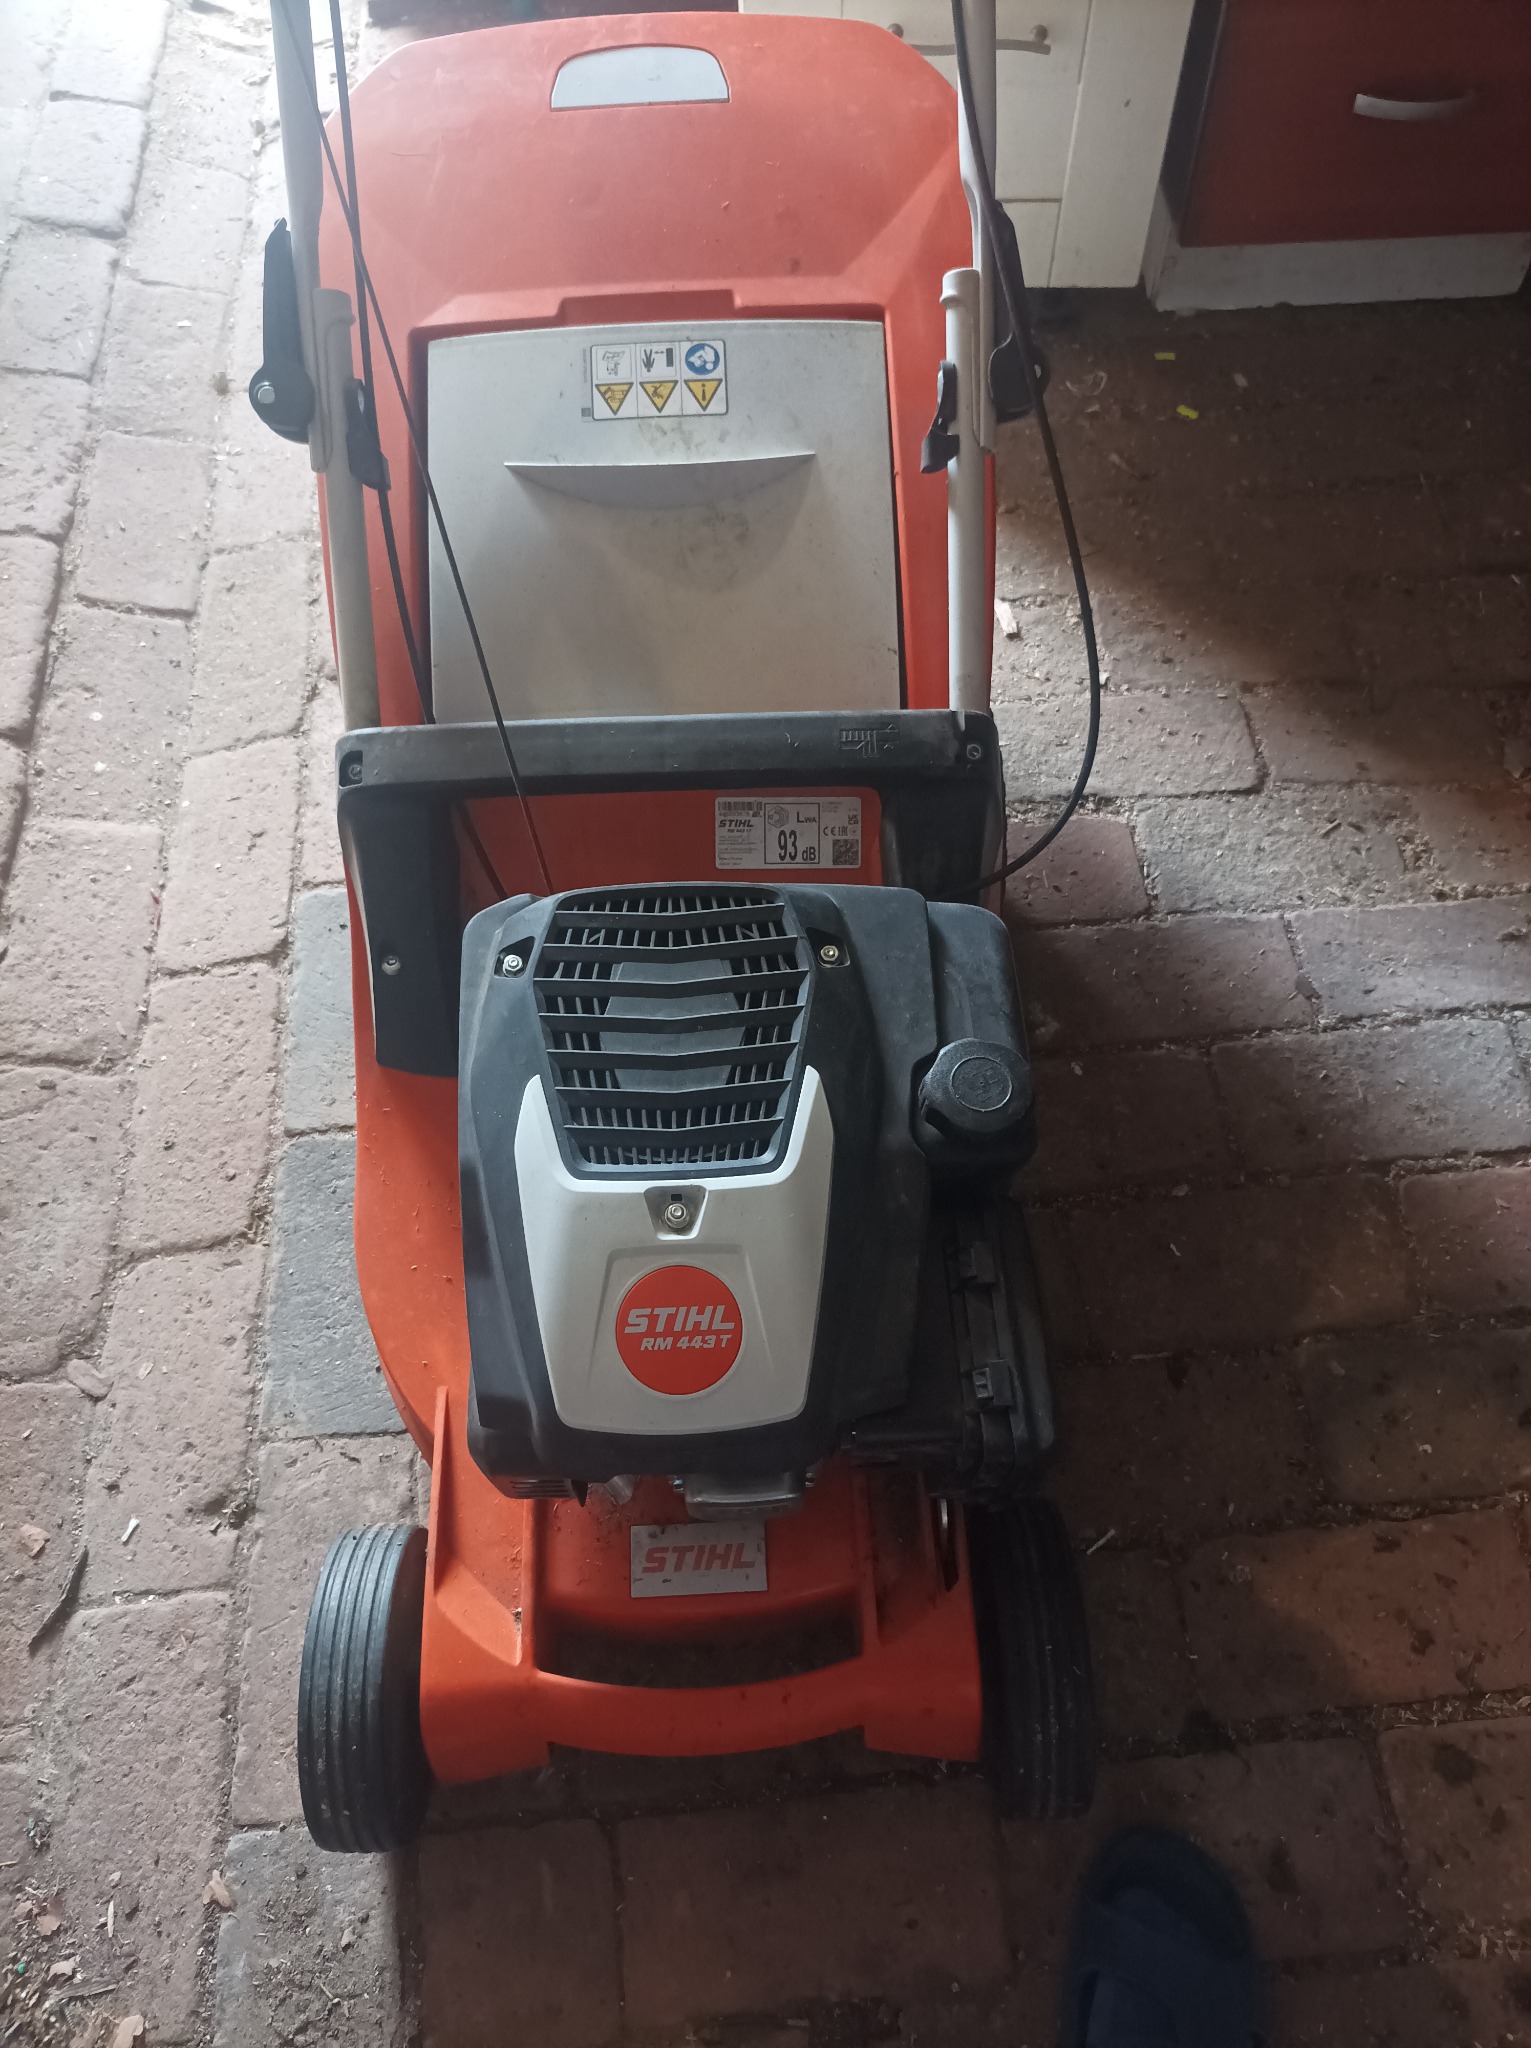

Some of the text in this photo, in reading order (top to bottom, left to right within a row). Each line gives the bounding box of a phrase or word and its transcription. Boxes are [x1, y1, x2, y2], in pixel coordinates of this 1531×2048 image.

[718, 819, 754, 828] STIHL
[778, 830, 816, 861] 93 dB
[624, 1305, 735, 1334] STIHL
[640, 1335, 732, 1351] RM 443 T
[642, 1543, 756, 1574] STIHL
